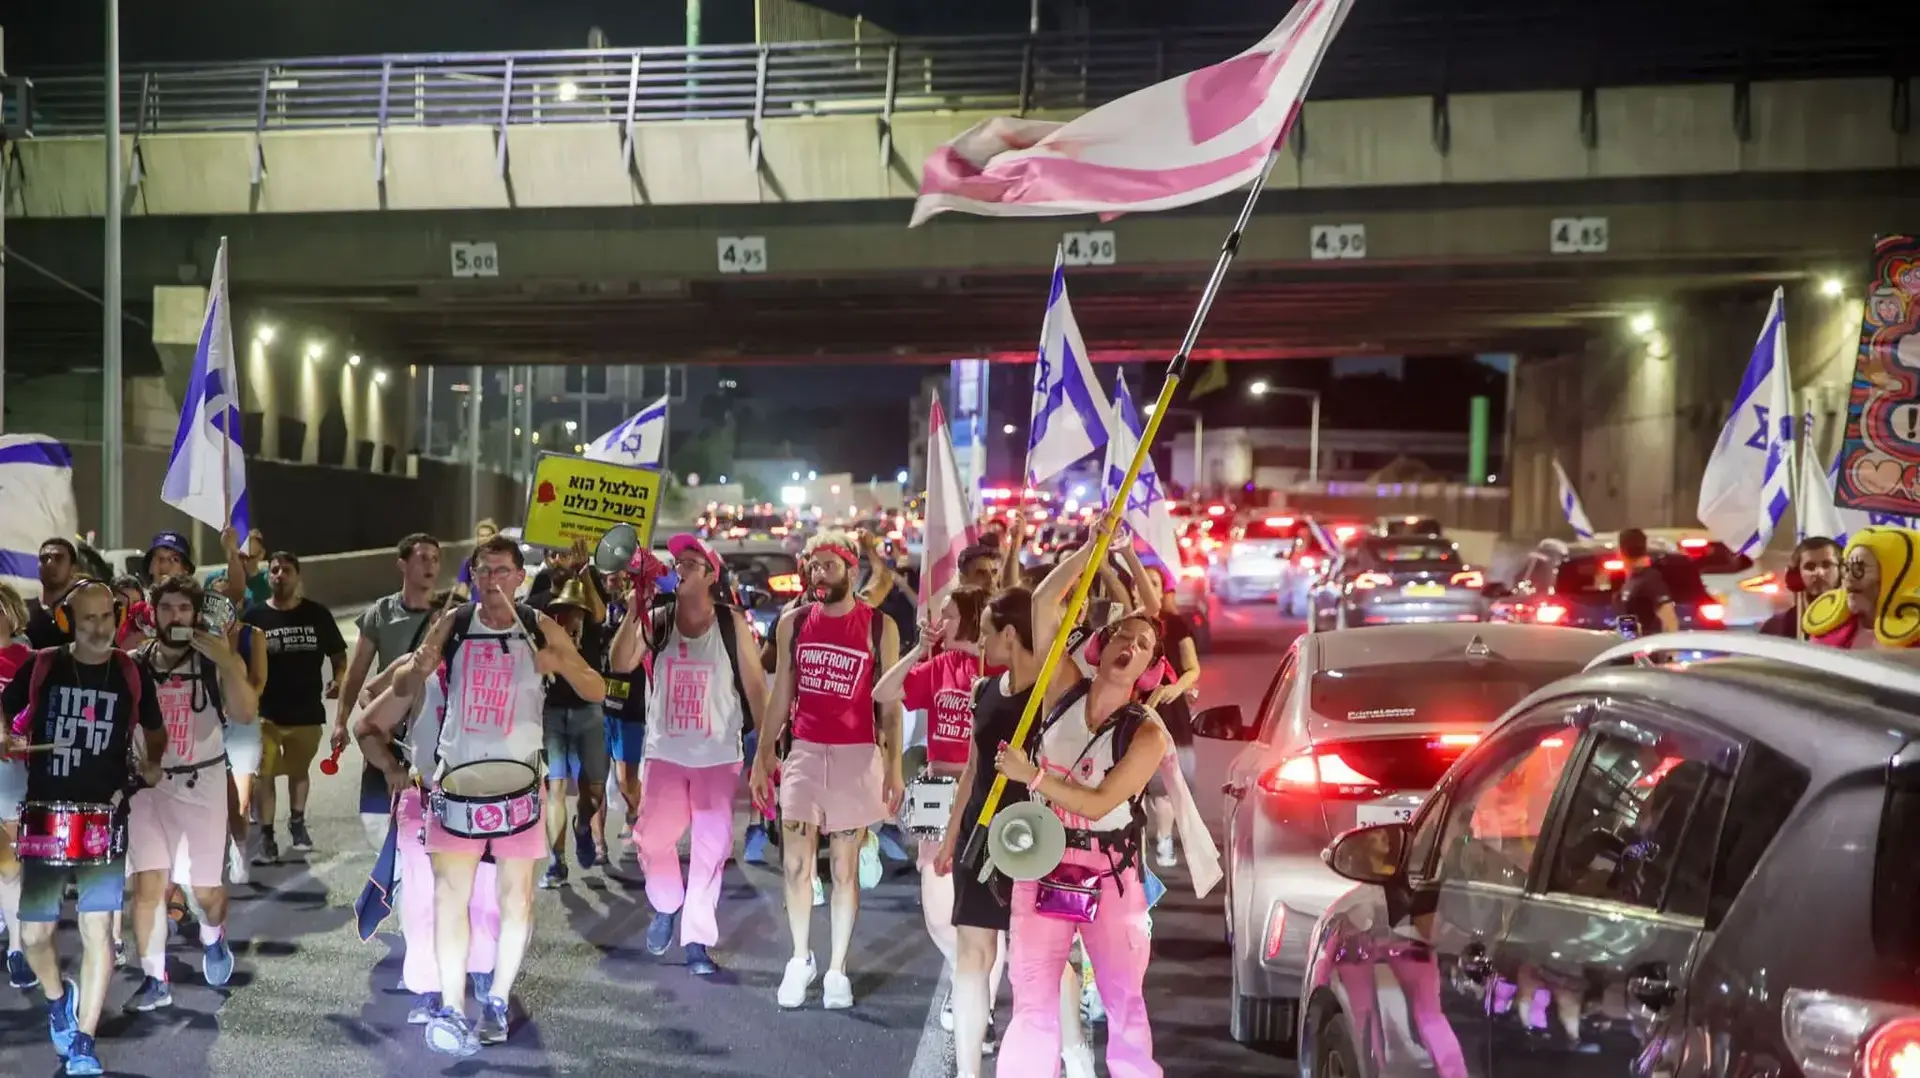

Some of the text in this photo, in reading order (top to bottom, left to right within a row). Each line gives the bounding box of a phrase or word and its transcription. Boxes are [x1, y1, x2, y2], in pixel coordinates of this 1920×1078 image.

[1066, 238, 1112, 258] 4.90
[1315, 231, 1363, 252] 4.90
[455, 249, 493, 270] 5.00
[723, 245, 762, 265] 4.95
[568, 475, 649, 500] הצלצול הוא
[563, 494, 646, 519] בשביל כולנו
[800, 649, 858, 672] PINKFRONT
[823, 679, 851, 695] החזית
[60, 686, 118, 720] דמו
[54, 715, 113, 756] קרט
[52, 747, 81, 777] יה
